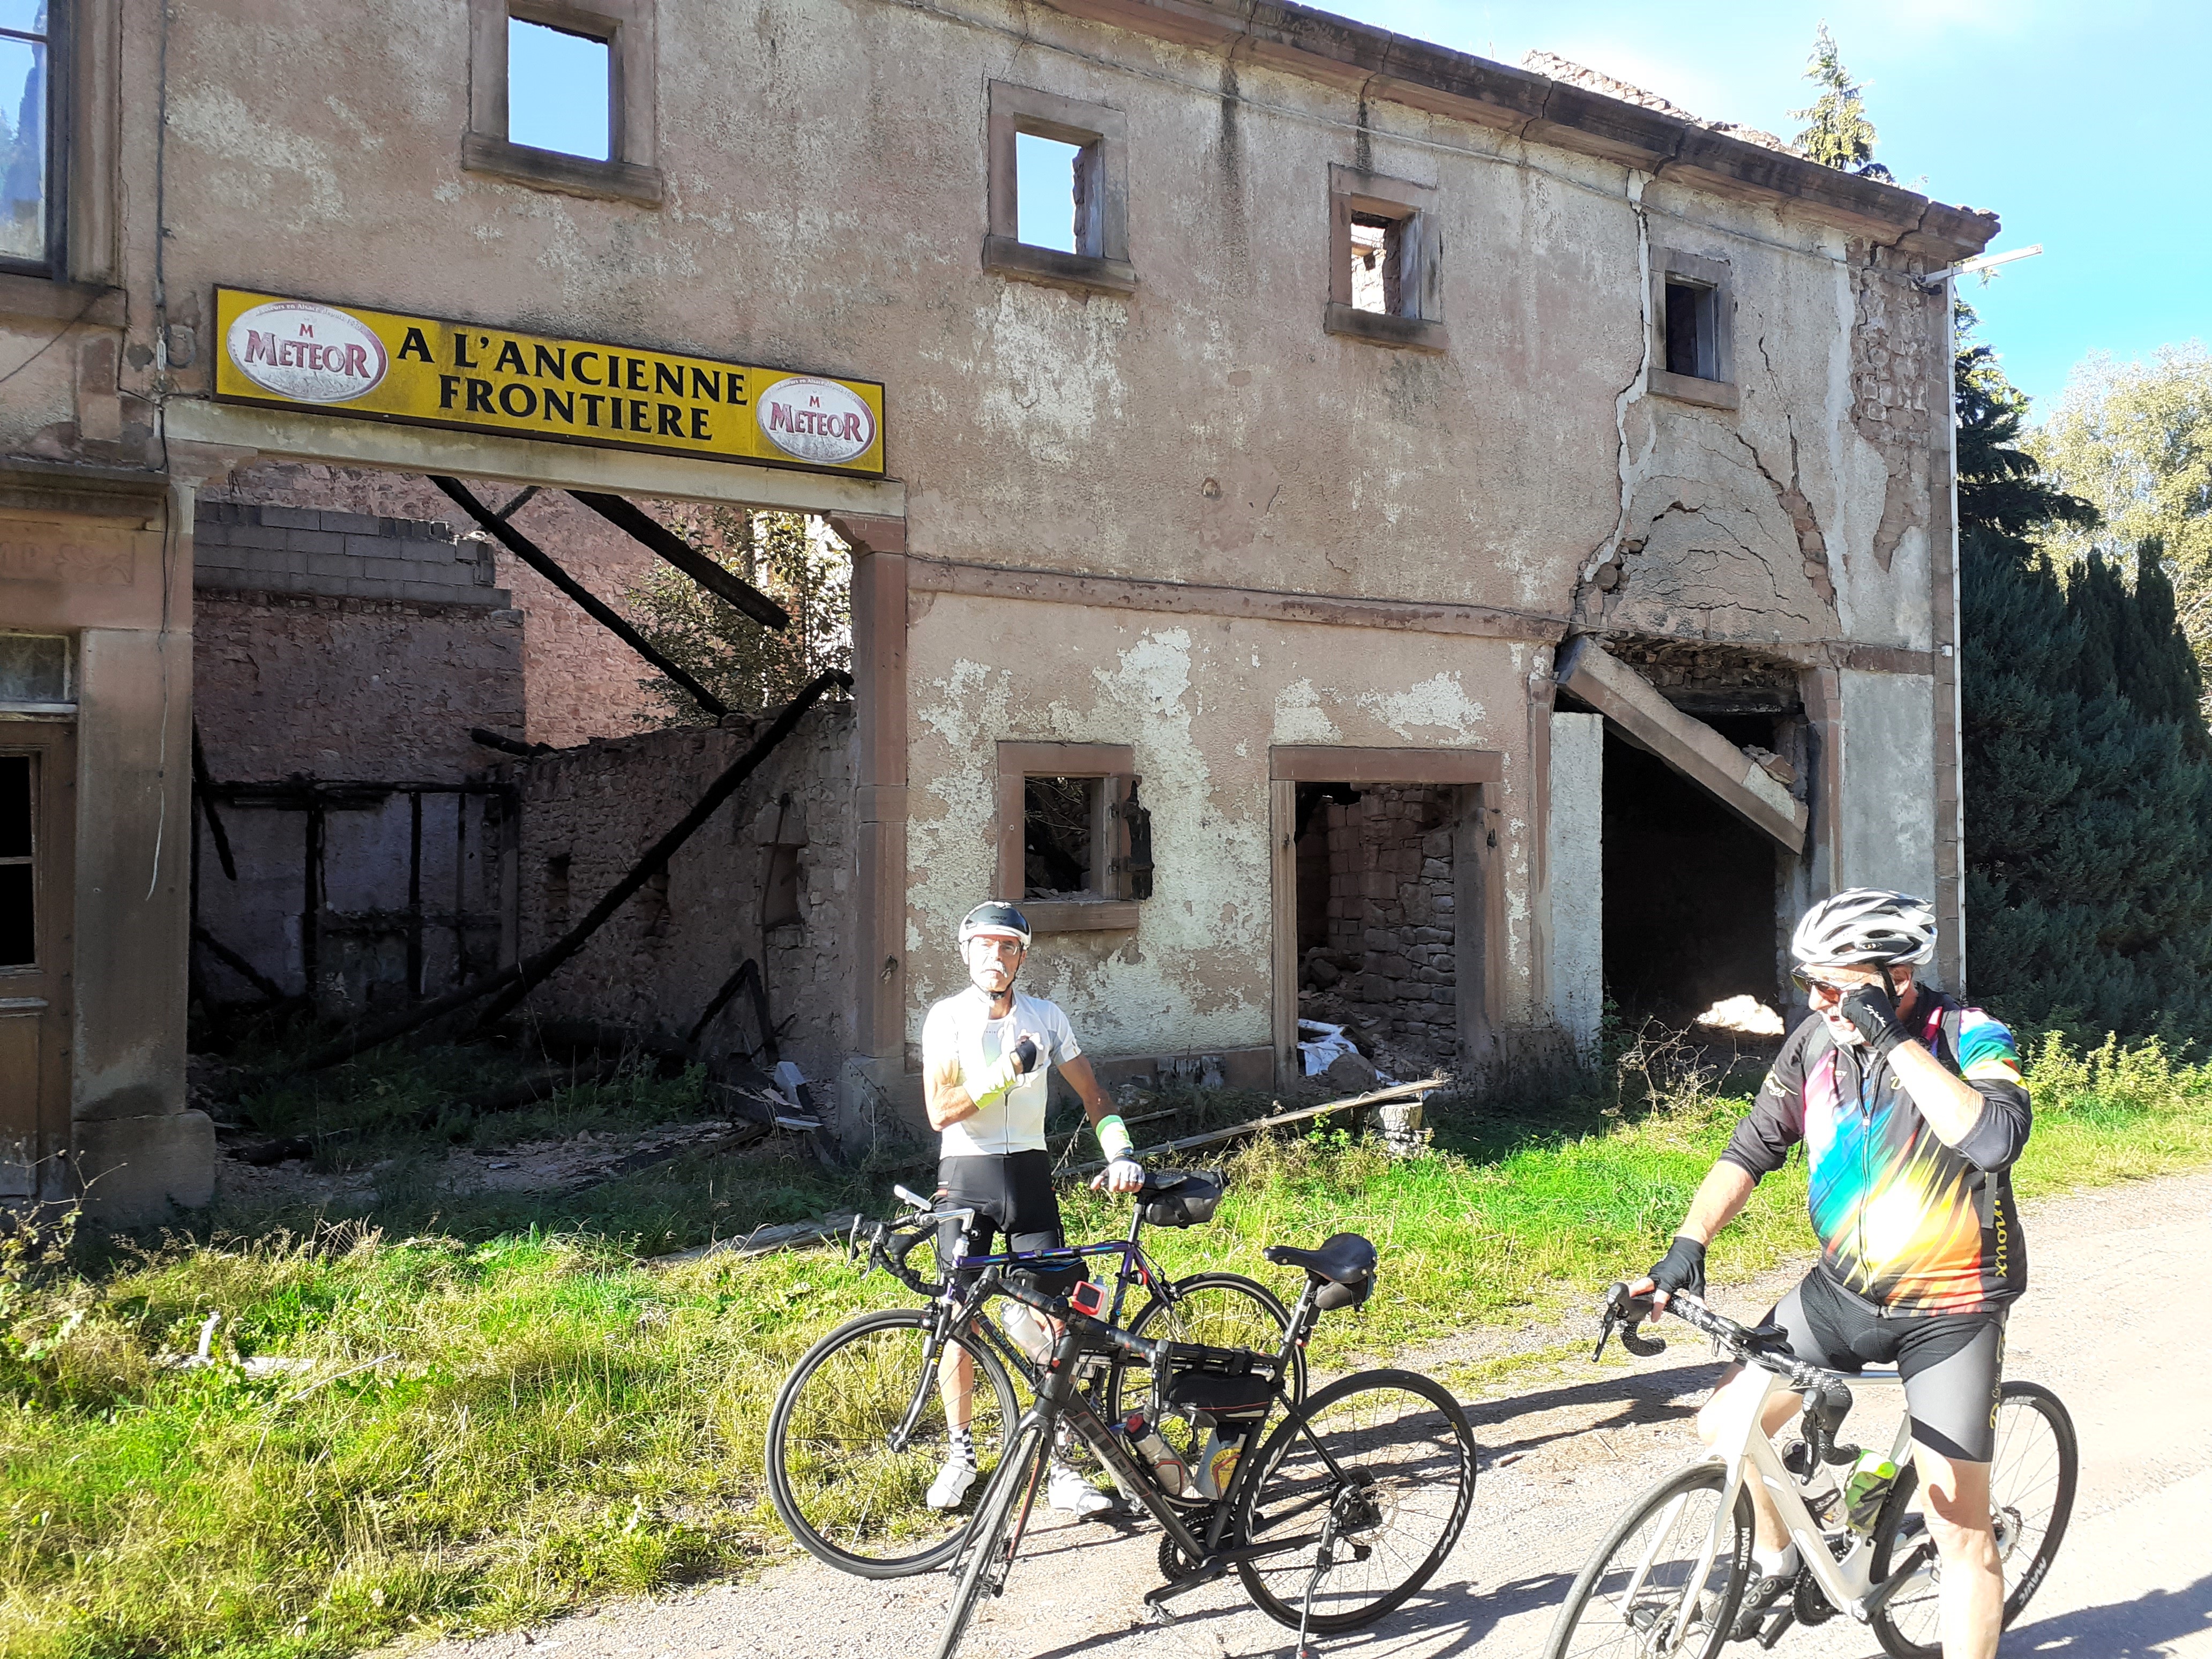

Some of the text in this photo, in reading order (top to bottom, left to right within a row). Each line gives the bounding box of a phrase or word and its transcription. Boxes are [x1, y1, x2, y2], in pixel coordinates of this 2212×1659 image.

[244, 329, 371, 378] METEOR
[299, 323, 314, 338] M
[397, 327, 748, 406] A L'ANCIENNE
[439, 373, 713, 441] FRONTIERE
[769, 401, 864, 442] METEOR
[810, 395, 820, 408] M
[1738, 1527, 1750, 1570] MAVIC
[2018, 1556, 2047, 1606] MAVIC
